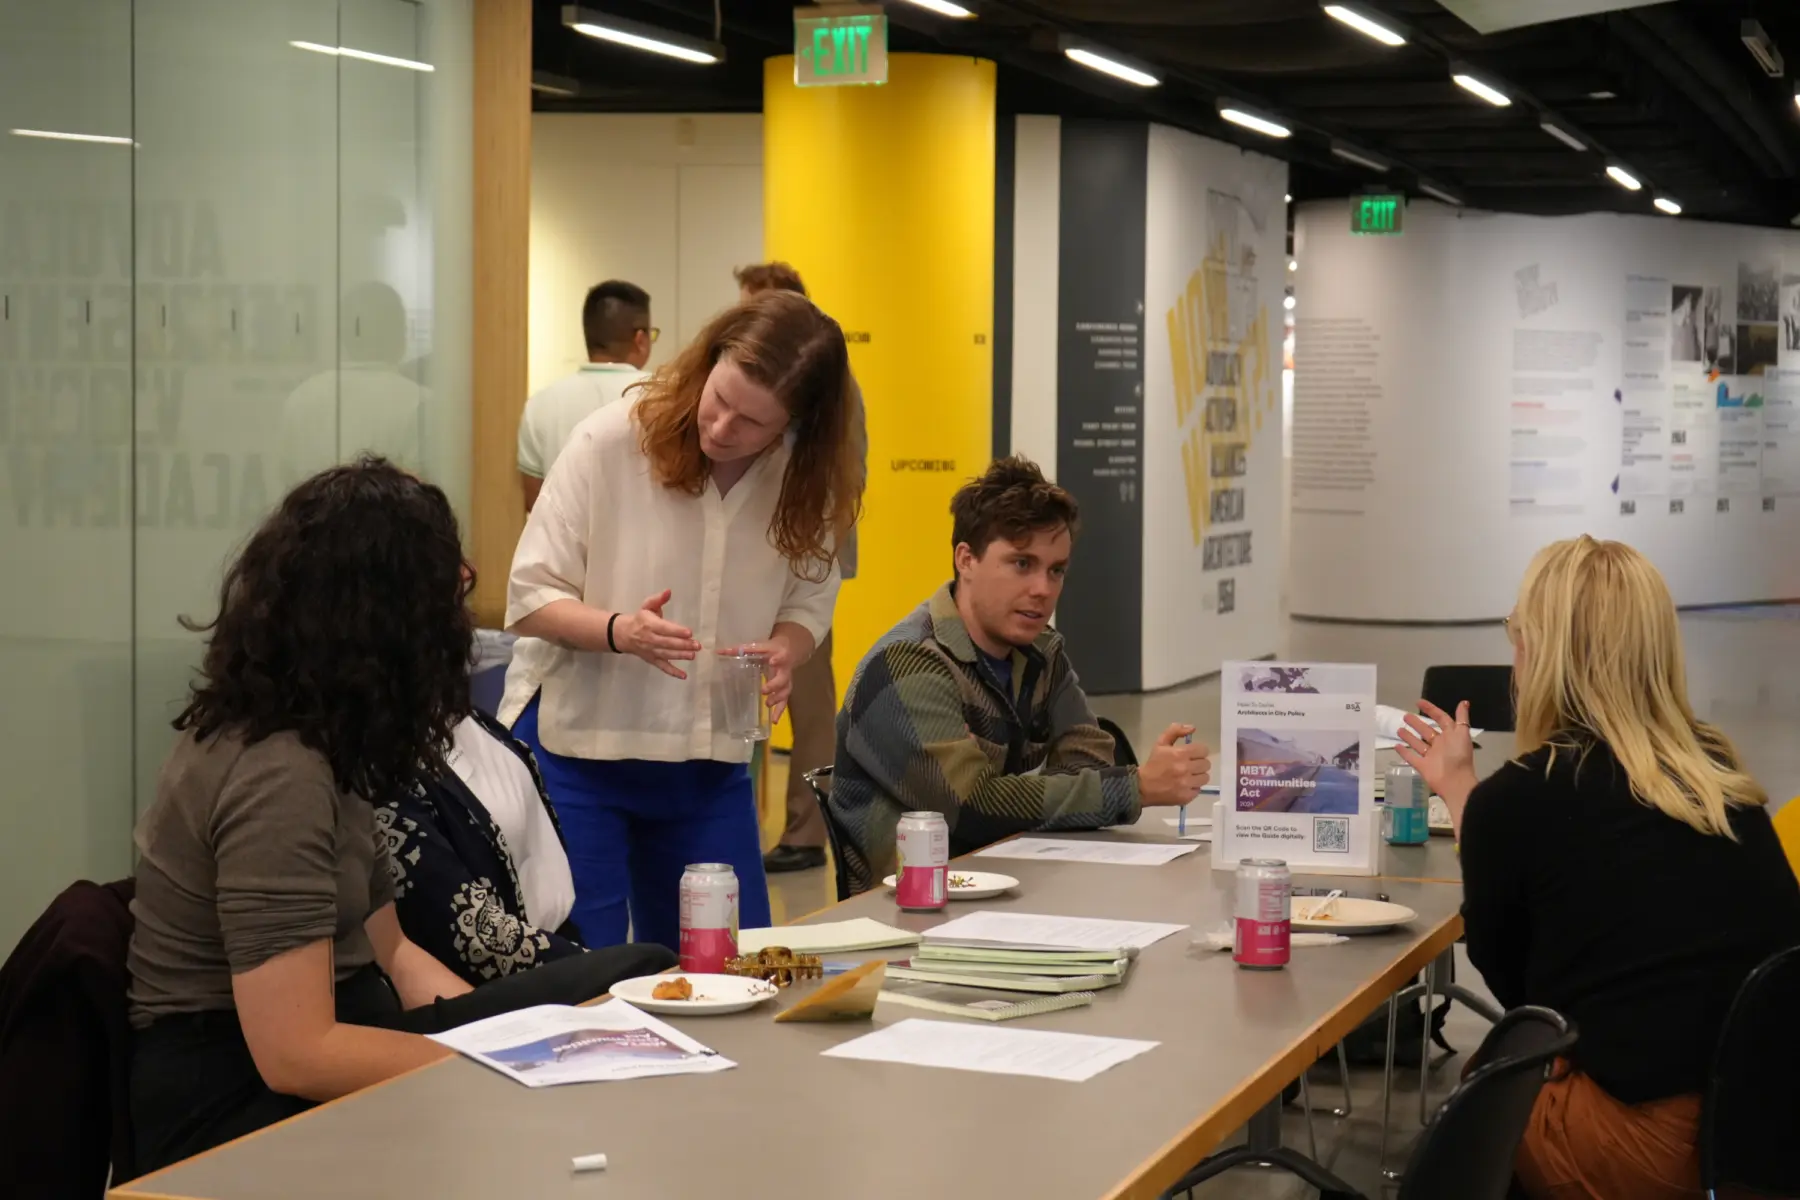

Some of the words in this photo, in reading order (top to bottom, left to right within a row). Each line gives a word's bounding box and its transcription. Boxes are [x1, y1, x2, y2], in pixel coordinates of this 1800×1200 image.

[813, 26, 872, 76] EXIT
[1361, 200, 1397, 230] EXIT
[890, 459, 956, 472] UPCOMING
[1240, 765, 1276, 776] MBTA
[1240, 776, 1317, 788] Communities
[1240, 787, 1261, 798] Act
